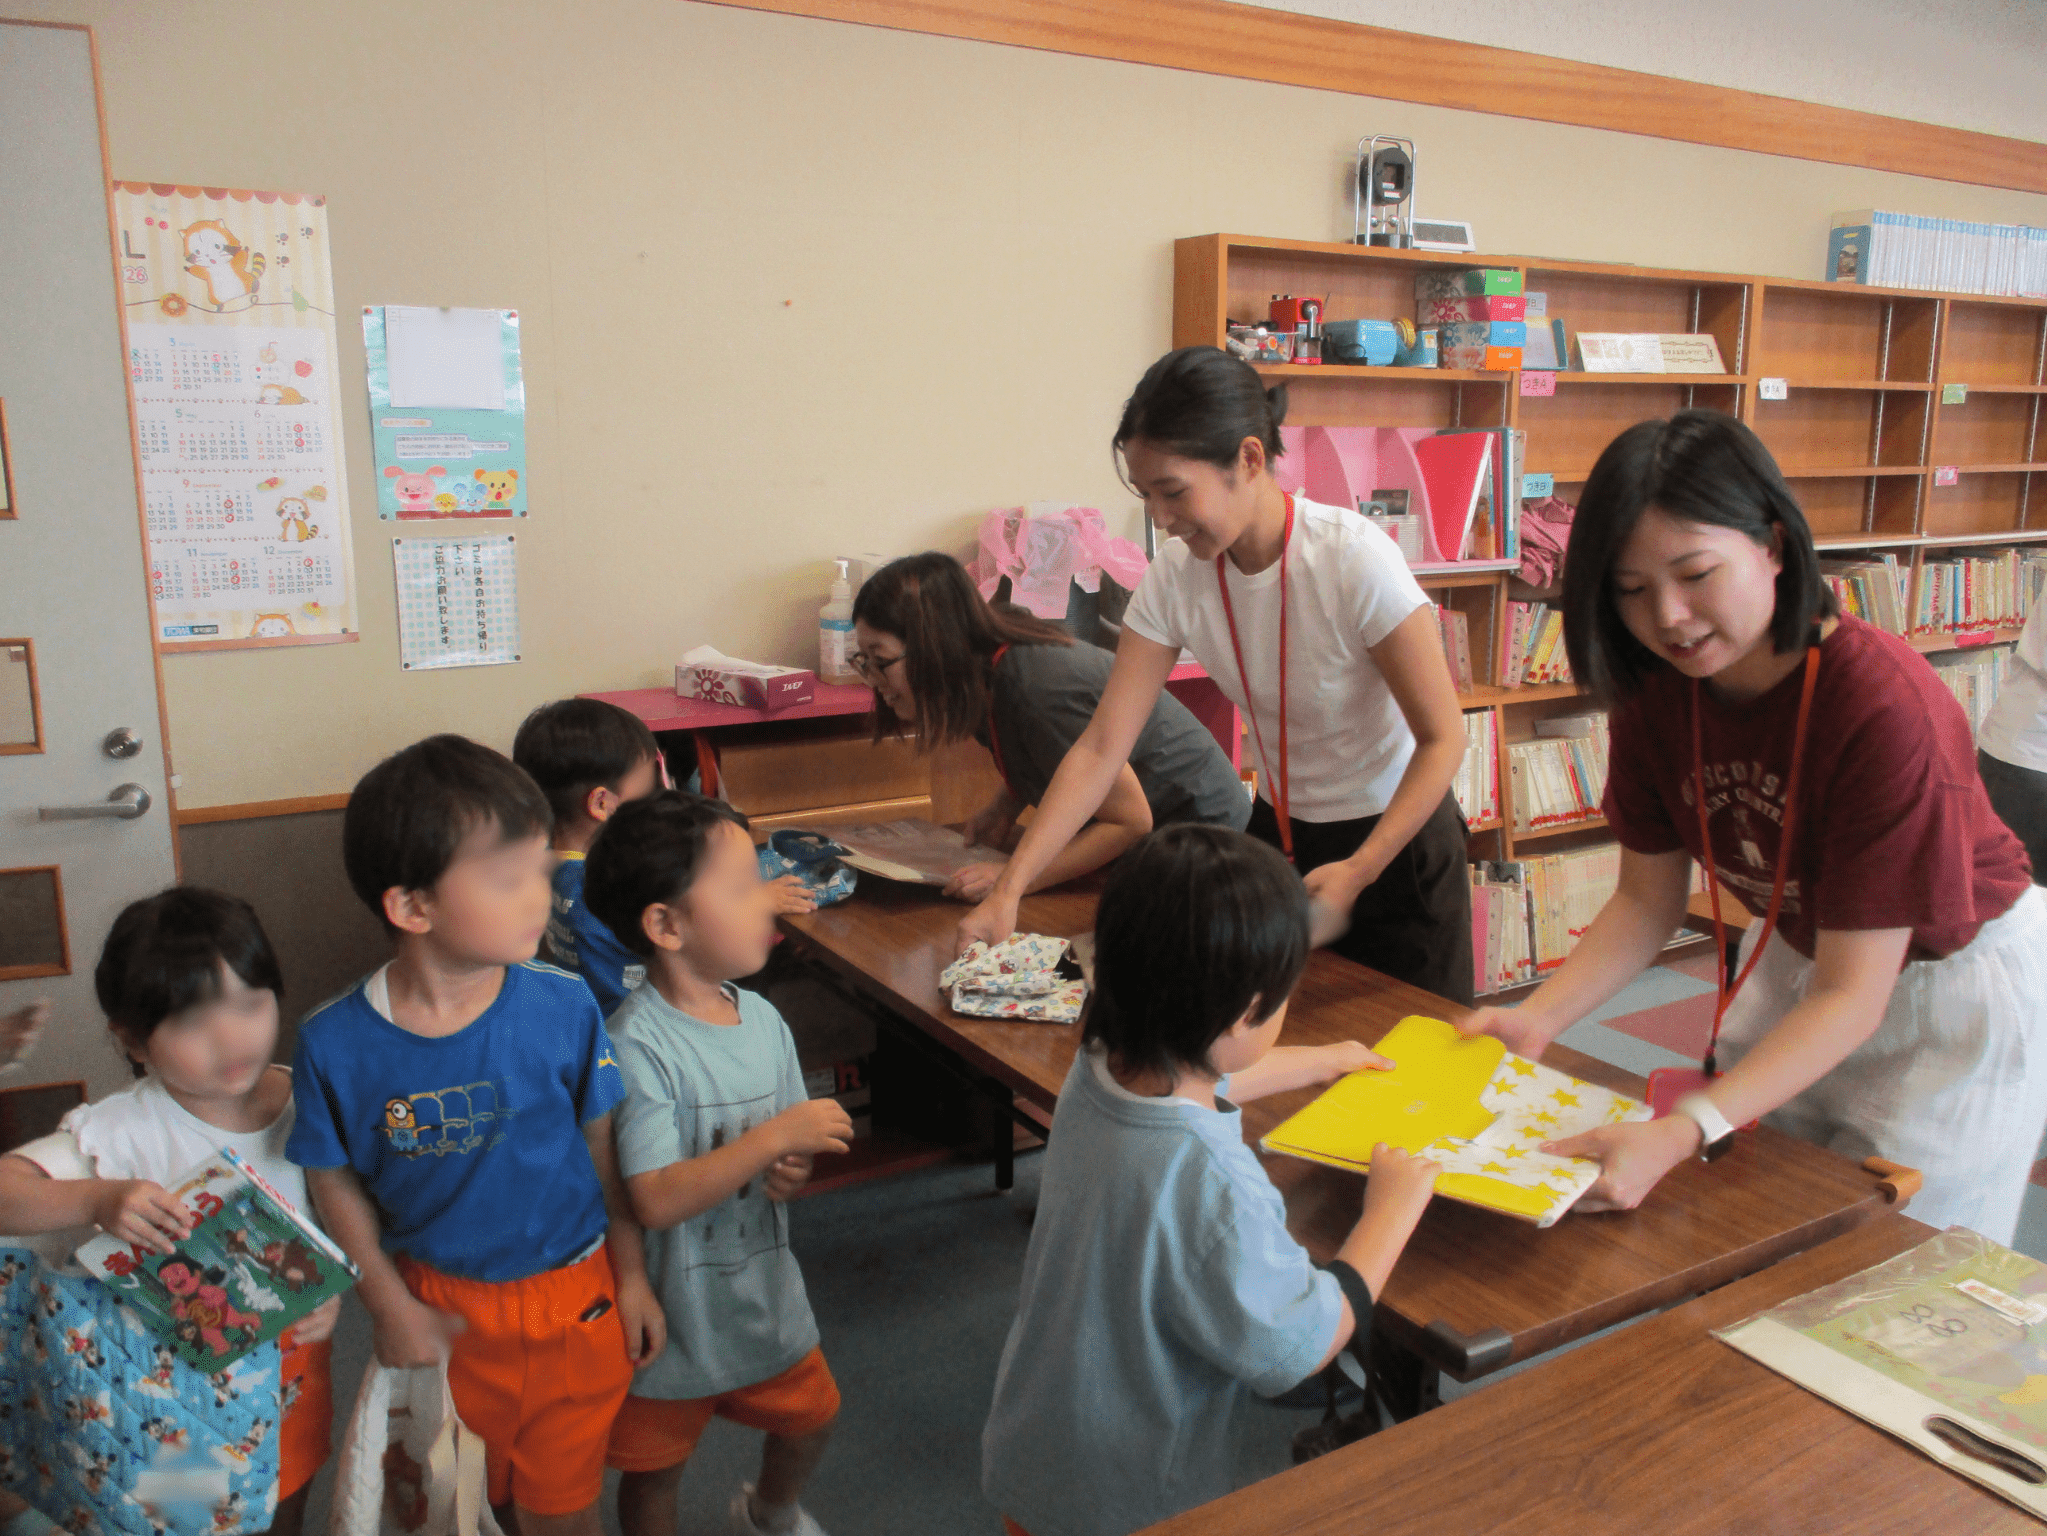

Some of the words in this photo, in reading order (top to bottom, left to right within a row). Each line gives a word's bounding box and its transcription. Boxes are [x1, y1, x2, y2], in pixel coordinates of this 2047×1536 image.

[187, 548, 197, 557] 11
[263, 546, 275, 555] 12
[452, 544, 467, 583] 下さい。
[434, 545, 452, 650] ご協力お願い致します。
[472, 544, 488, 652] ゴミは各自お持ち帰り
